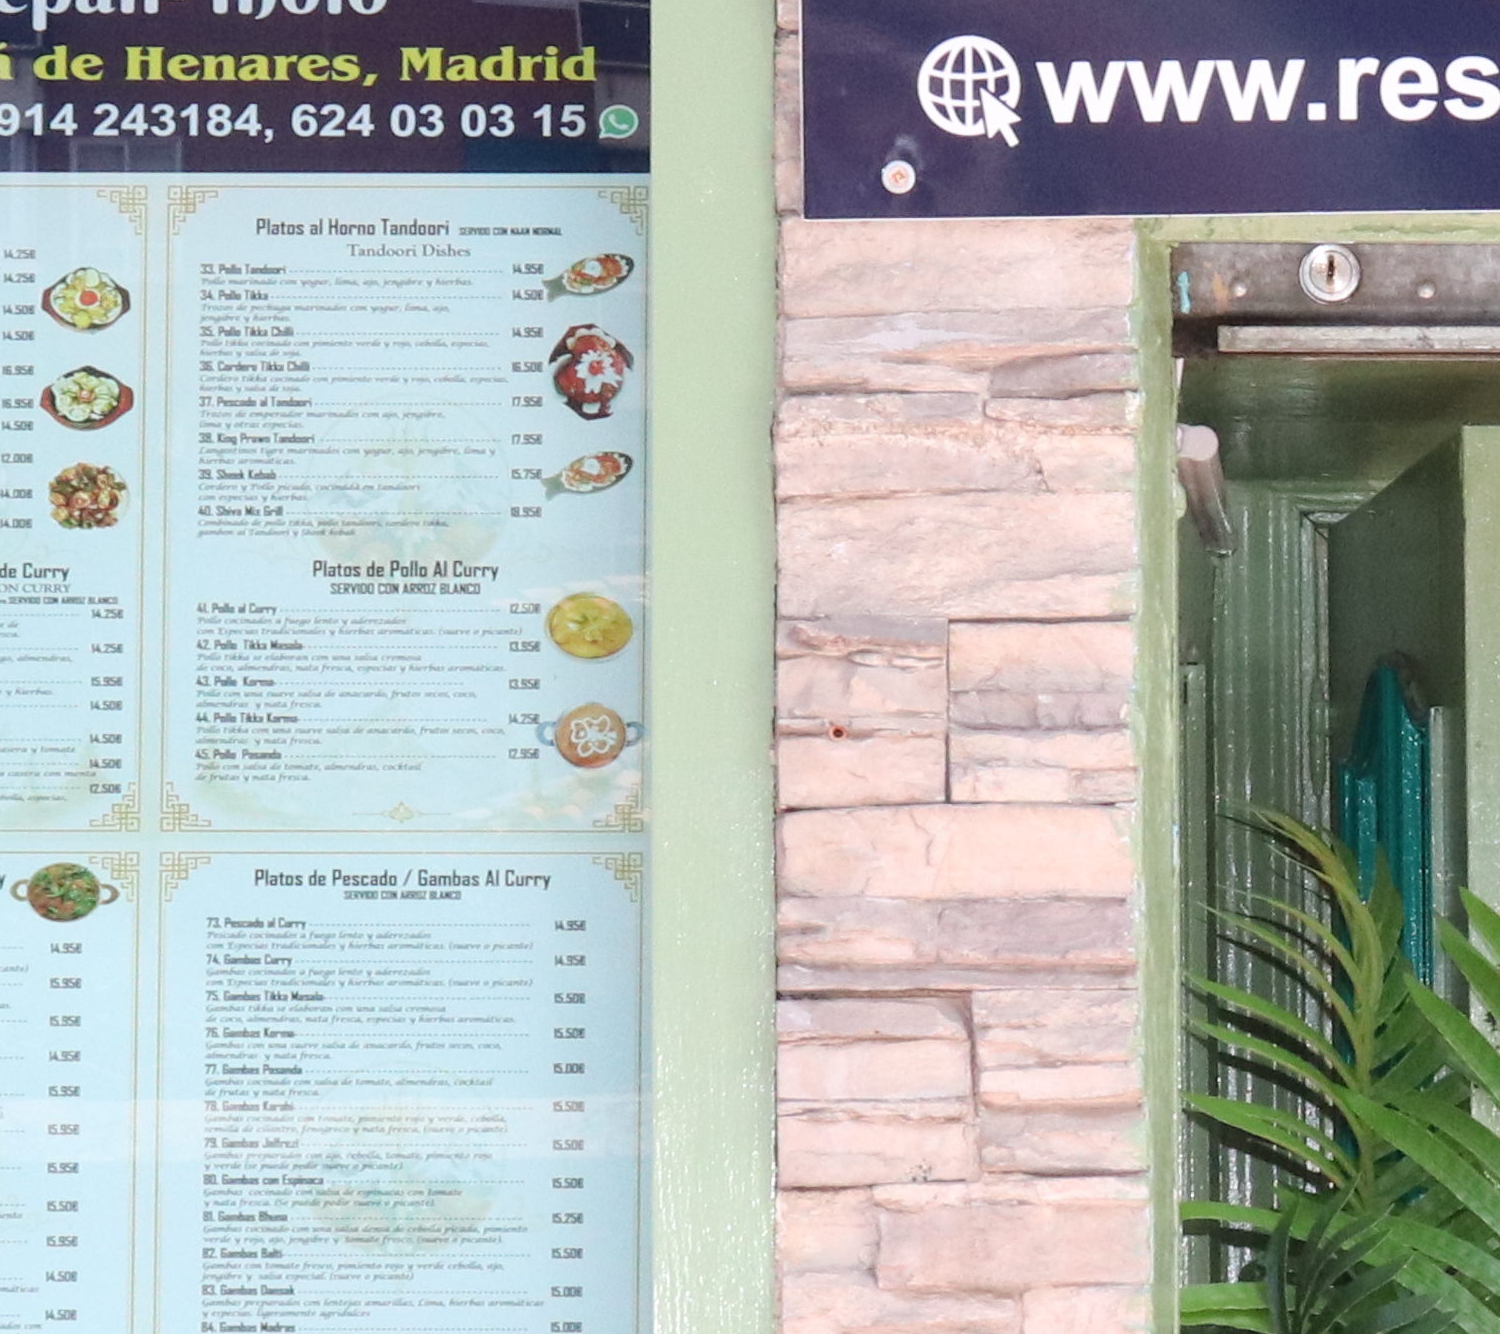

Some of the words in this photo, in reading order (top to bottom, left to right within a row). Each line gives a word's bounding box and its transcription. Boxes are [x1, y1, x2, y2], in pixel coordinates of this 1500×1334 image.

[33, 45, 103, 81] de
[125, 46, 378, 87] Henares,
[400, 45, 597, 82] Madrid
[93, 103, 274, 144] 243184,
[291, 103, 375, 137] 624
[390, 104, 445, 138] 03
[461, 104, 515, 138] 03
[533, 104, 586, 137] 15
[256, 218, 304, 235] Platos
[310, 218, 323, 235] al
[329, 218, 375, 235] Horno
[381, 218, 449, 235] Tandoori
[347, 243, 417, 257] Tandoori
[422, 244, 471, 257] Dishes
[0, 563, 17, 578] de
[23, 563, 69, 581] Curry
[313, 560, 361, 577] Platos
[366, 561, 384, 577] de
[390, 560, 427, 578] Pollo
[433, 561, 447, 578] Al
[453, 560, 499, 581] Curry
[22, 581, 71, 593] CURRY
[331, 583, 374, 594] SERVIDO
[378, 583, 399, 594] CON
[402, 583, 436, 594] ARROZ
[440, 583, 481, 594] BLANCO
[255, 869, 303, 886] Platos
[309, 870, 326, 886] de
[332, 869, 397, 886] Pescado
[403, 870, 412, 886] /
[418, 869, 479, 886] Gambas
[485, 870, 499, 886] Al
[505, 870, 551, 890] Curry
